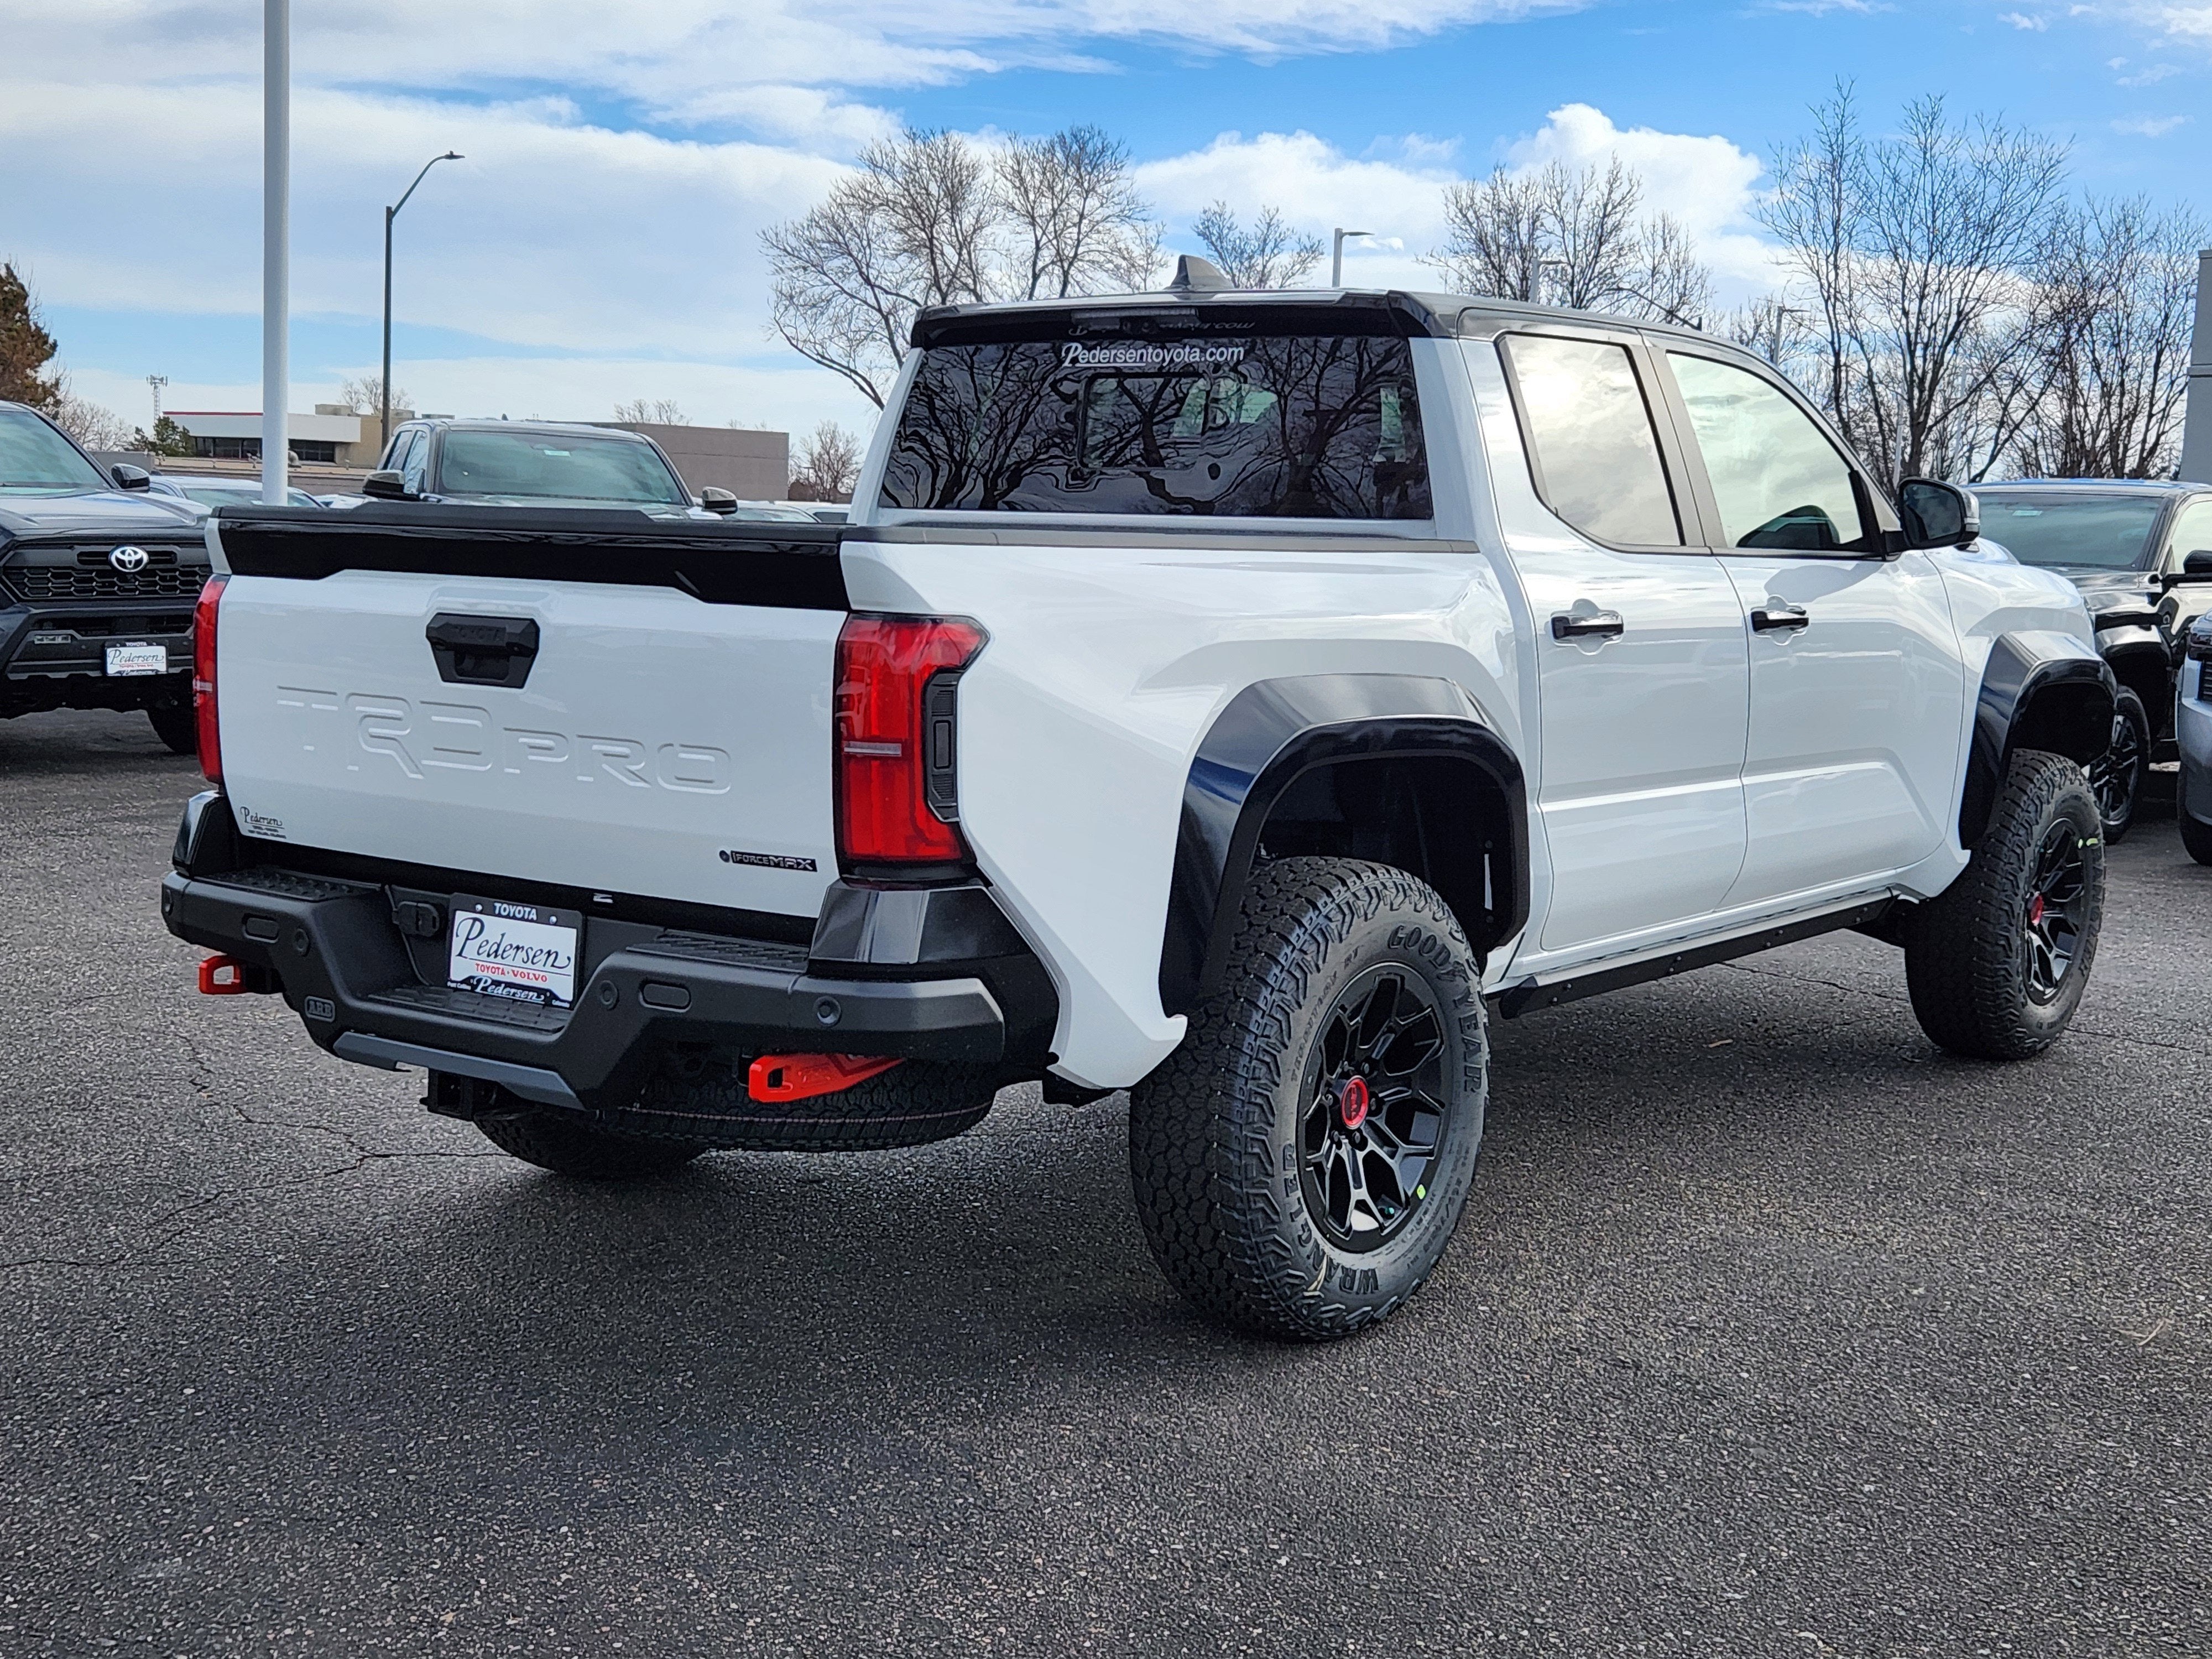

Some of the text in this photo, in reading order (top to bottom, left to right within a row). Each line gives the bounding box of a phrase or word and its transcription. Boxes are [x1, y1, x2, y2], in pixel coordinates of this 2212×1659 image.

[1061, 343, 1244, 367] Pedersentoyota.com
[108, 649, 164, 665] Pedersen
[494, 902, 536, 920] TOYOTA
[456, 917, 571, 969] Pedersen
[475, 963, 547, 982] TOYOTA VOLVO
[474, 976, 545, 1001] Pedersen
[1388, 925, 1482, 1092] GOODYEAR
[1283, 1143, 1379, 1295] WRANGLER
